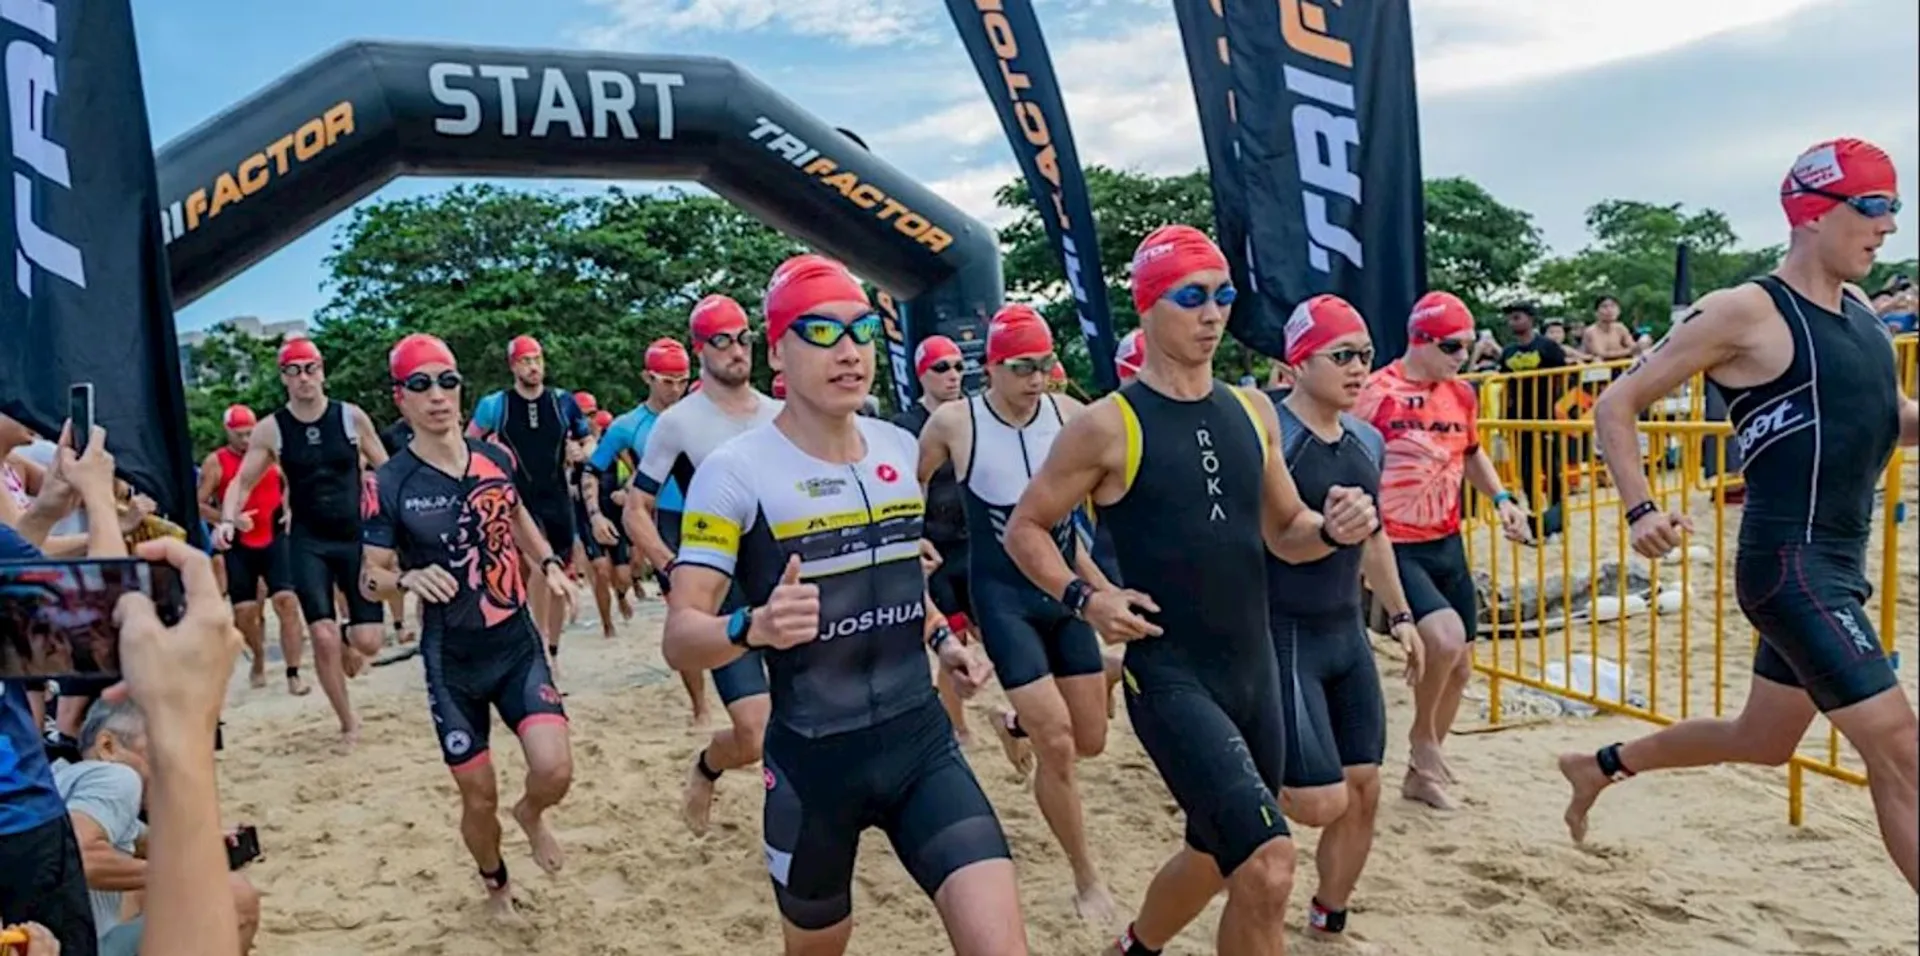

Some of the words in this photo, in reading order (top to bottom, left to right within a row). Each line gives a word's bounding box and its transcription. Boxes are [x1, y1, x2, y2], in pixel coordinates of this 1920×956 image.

[428, 62, 686, 140] START
[973, 0, 1099, 340] TRIFACTO
[1281, 0, 1364, 273] TRIF
[749, 116, 954, 254] TRIFACTOR
[820, 601, 925, 641] JOSHUA
